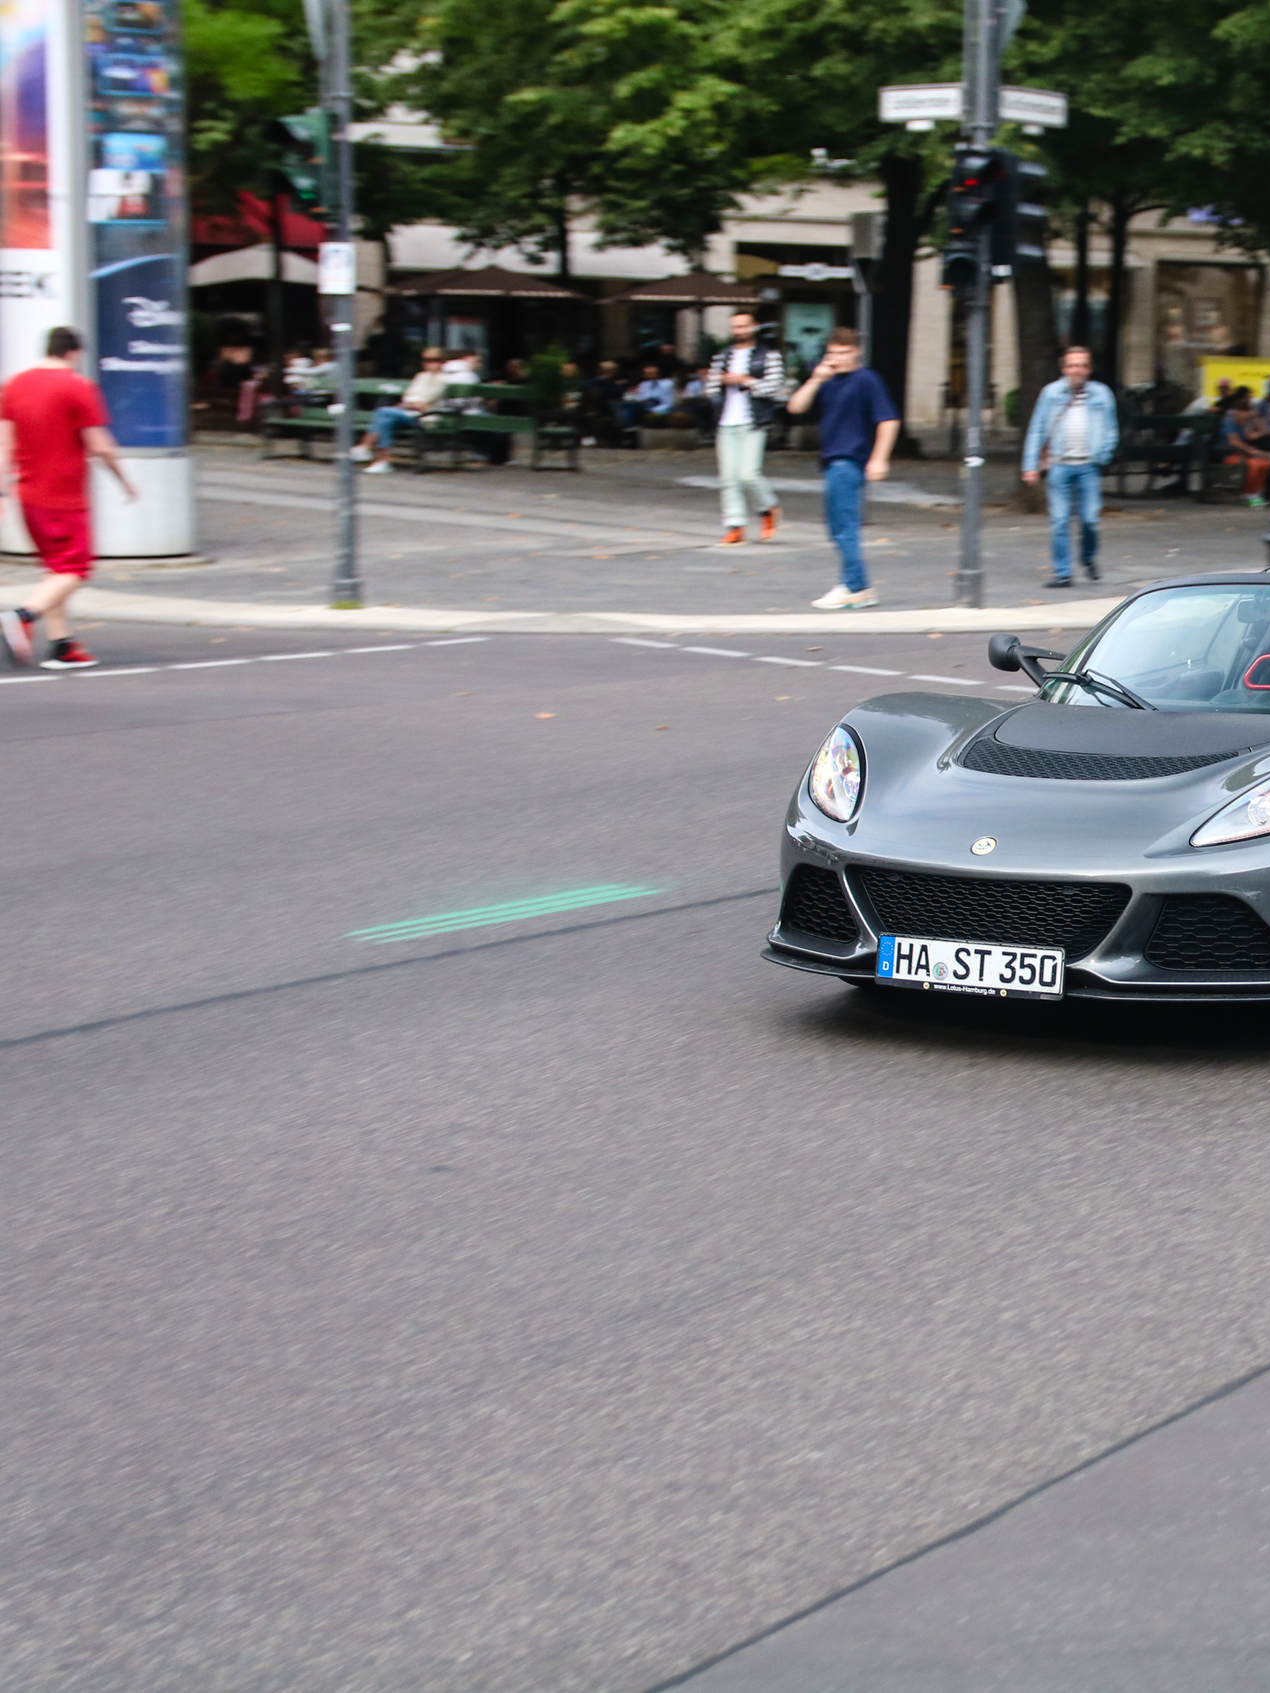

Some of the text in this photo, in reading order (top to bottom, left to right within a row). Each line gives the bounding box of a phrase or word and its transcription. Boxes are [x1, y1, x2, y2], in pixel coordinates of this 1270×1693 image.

[882, 961, 890, 971] D
[895, 942, 1058, 988] HA ST 350
